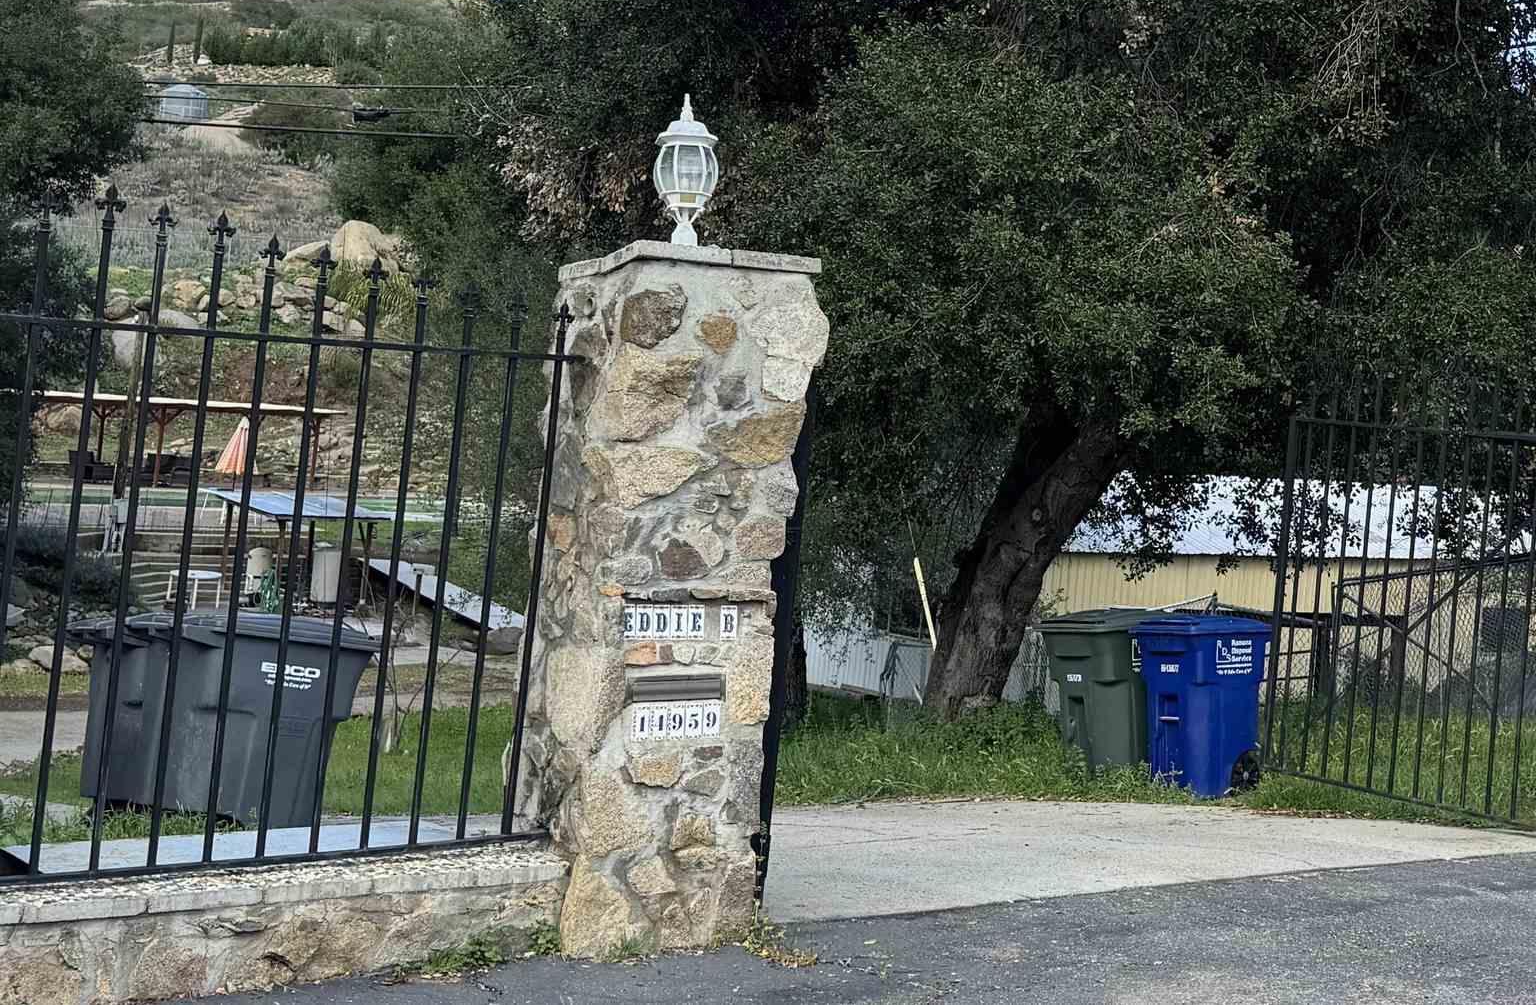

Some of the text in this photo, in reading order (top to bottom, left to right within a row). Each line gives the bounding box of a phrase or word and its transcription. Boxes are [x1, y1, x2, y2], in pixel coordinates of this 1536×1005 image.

[624, 612, 735, 633] EDDIE B
[639, 711, 717, 733] 11959
